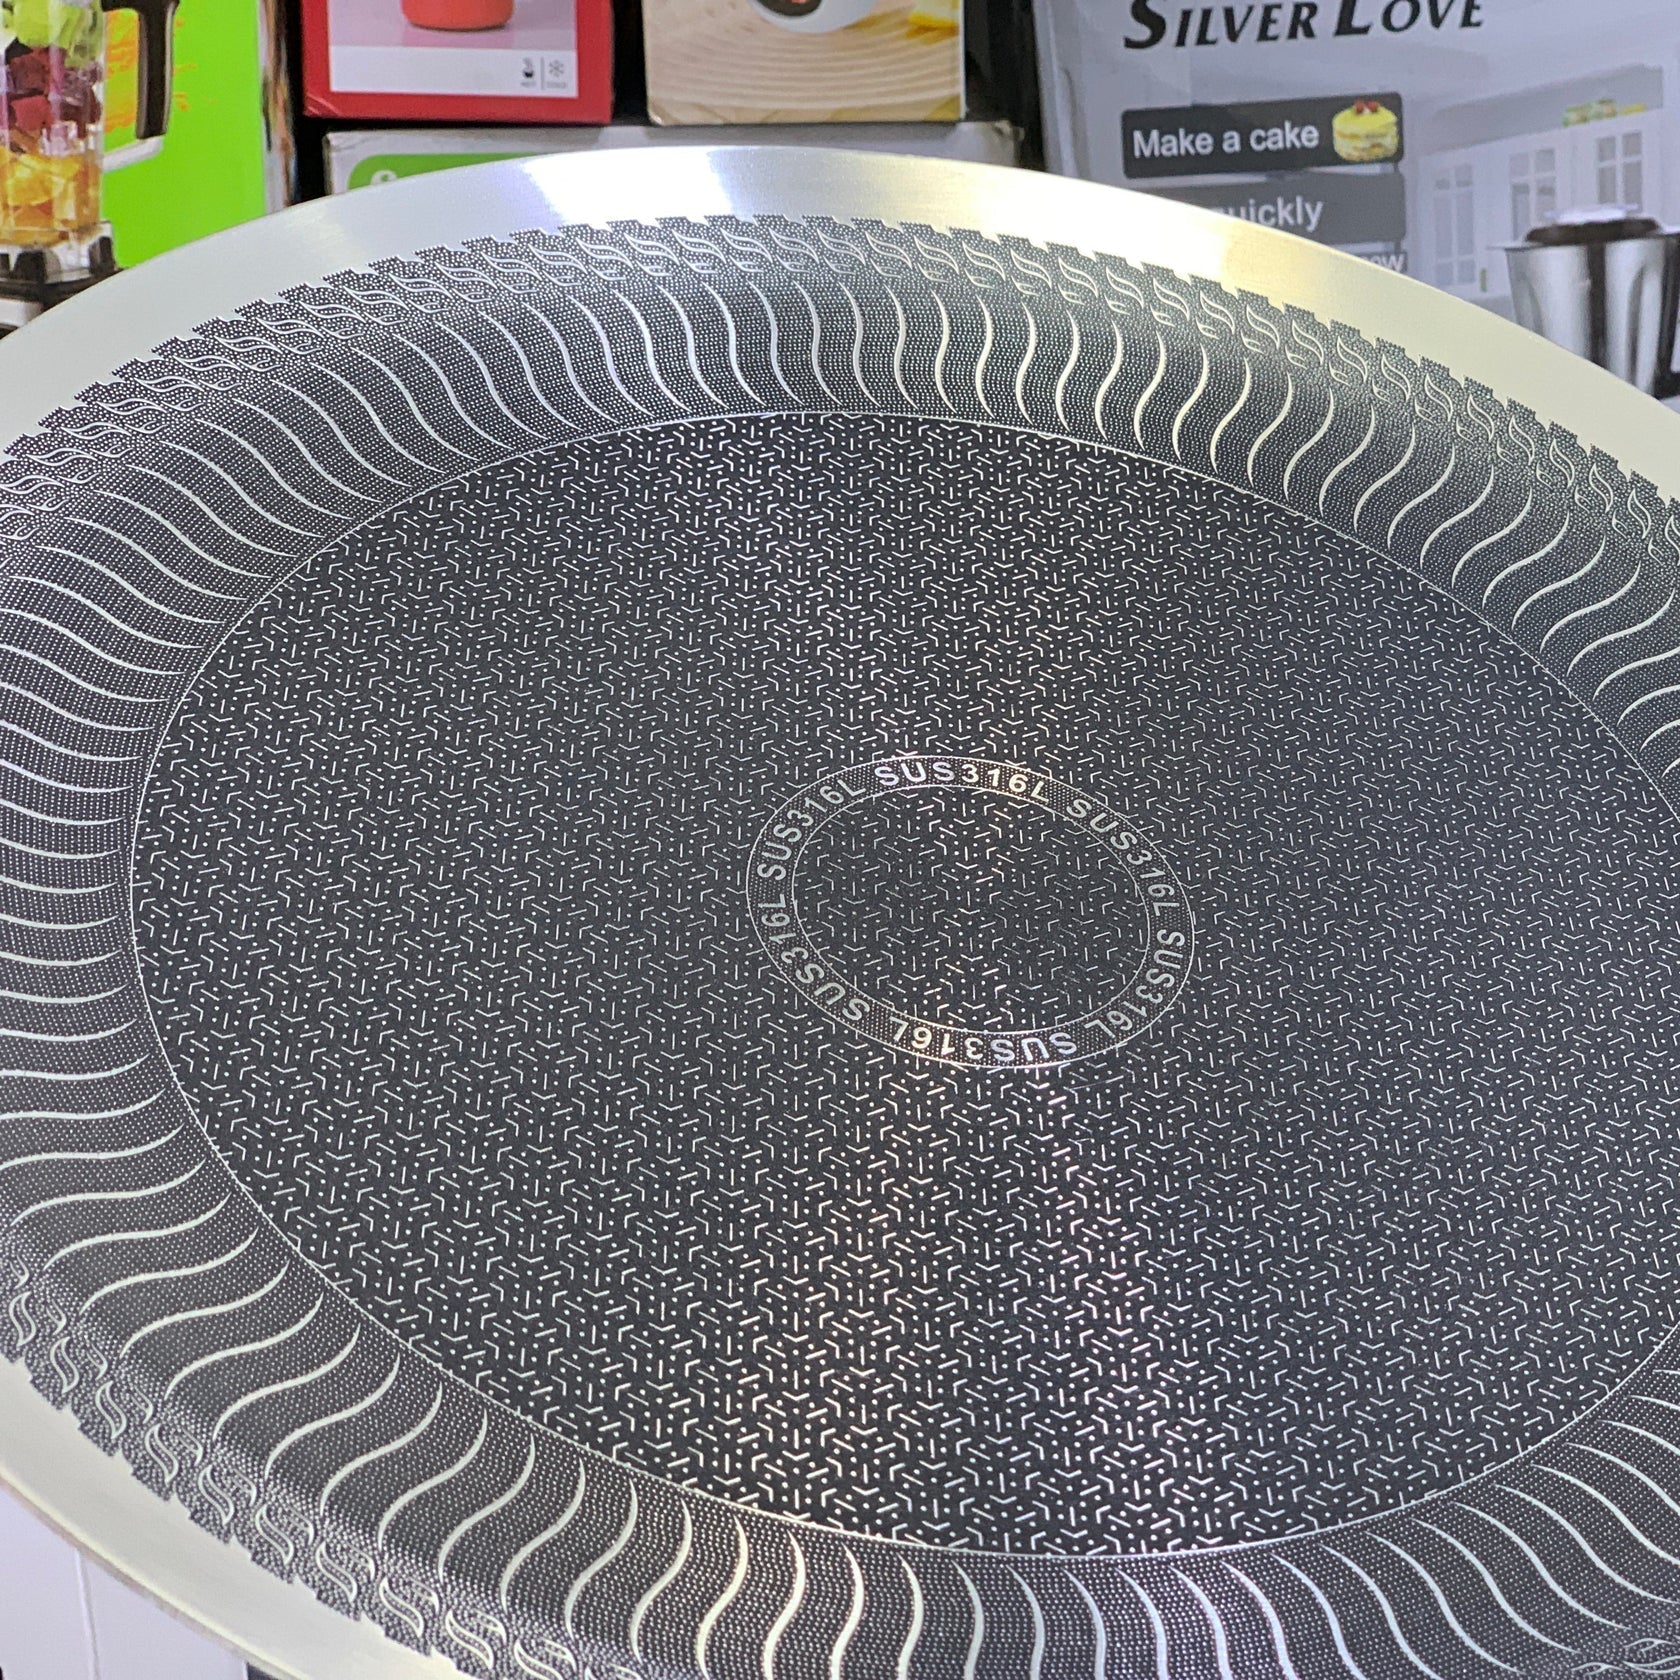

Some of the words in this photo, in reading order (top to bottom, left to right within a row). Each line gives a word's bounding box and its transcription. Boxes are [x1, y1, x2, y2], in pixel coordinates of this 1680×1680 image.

[1132, 129, 1215, 158] Make
[1221, 130, 1242, 153] a
[1249, 120, 1320, 150] cake
[756, 779, 866, 881] SUS316L
[874, 760, 1051, 804] SUS316L
[1066, 798, 1177, 917] SUS316L
[757, 893, 871, 1021] SUS316L
[1084, 928, 1185, 1040] SUS316L
[888, 1016, 1078, 1063] SUS316L
